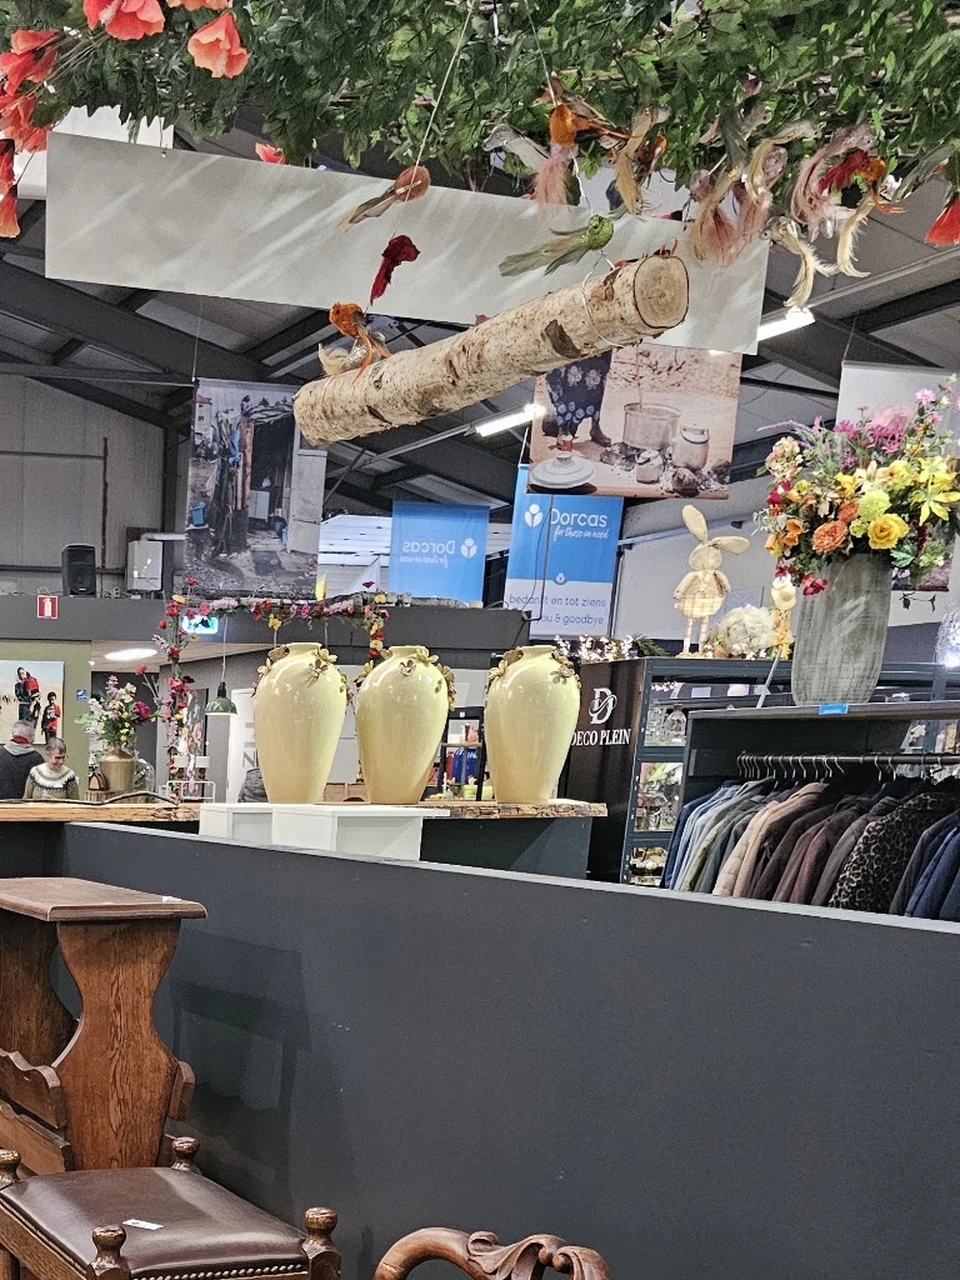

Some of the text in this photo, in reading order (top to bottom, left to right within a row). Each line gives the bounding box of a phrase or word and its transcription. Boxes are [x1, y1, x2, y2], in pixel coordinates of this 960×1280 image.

[550, 508, 608, 528] Dorcas
[509, 594, 549, 605] bedant
[599, 728, 631, 746] PLEIN
